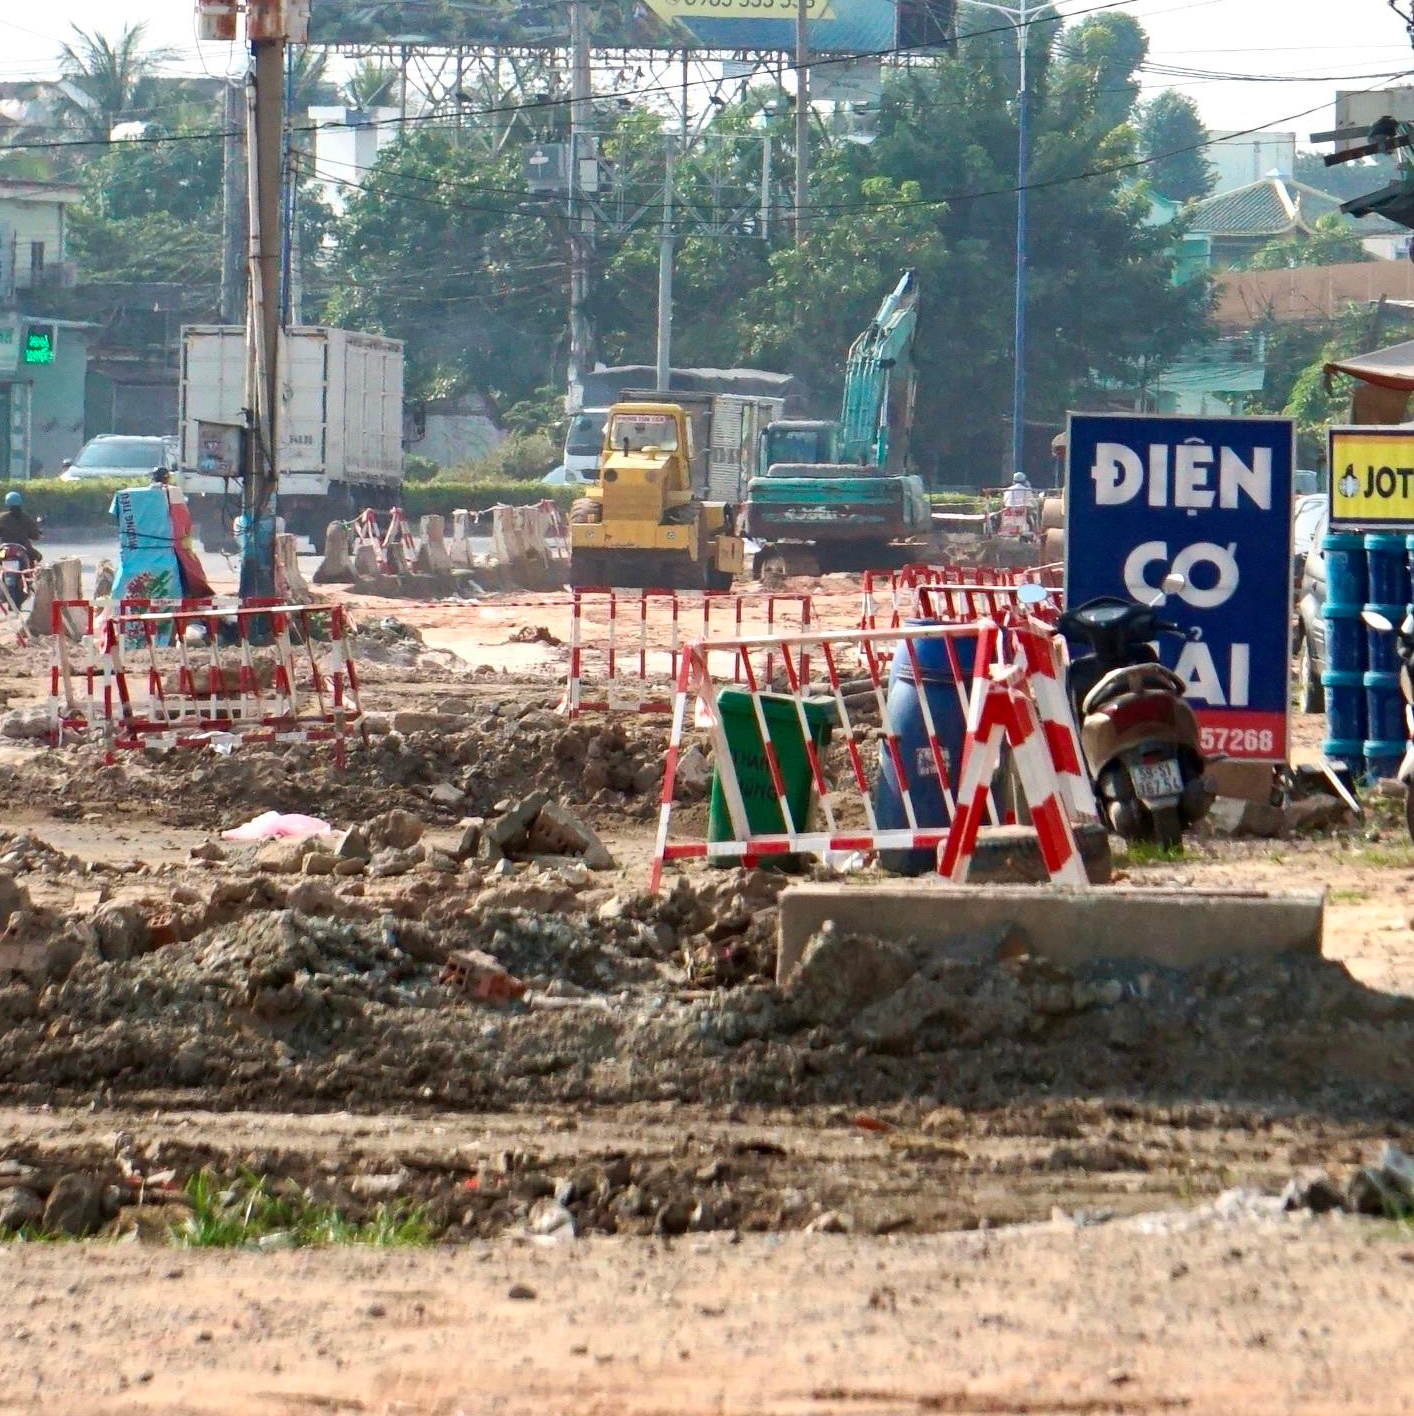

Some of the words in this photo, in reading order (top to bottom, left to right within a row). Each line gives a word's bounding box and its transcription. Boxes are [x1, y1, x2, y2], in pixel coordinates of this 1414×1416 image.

[1091, 438, 1272, 516] ĐIỆN
[1124, 540, 1239, 608] CƠ
[1150, 626, 1250, 706] ẢI
[1200, 727, 1274, 752] 57268
